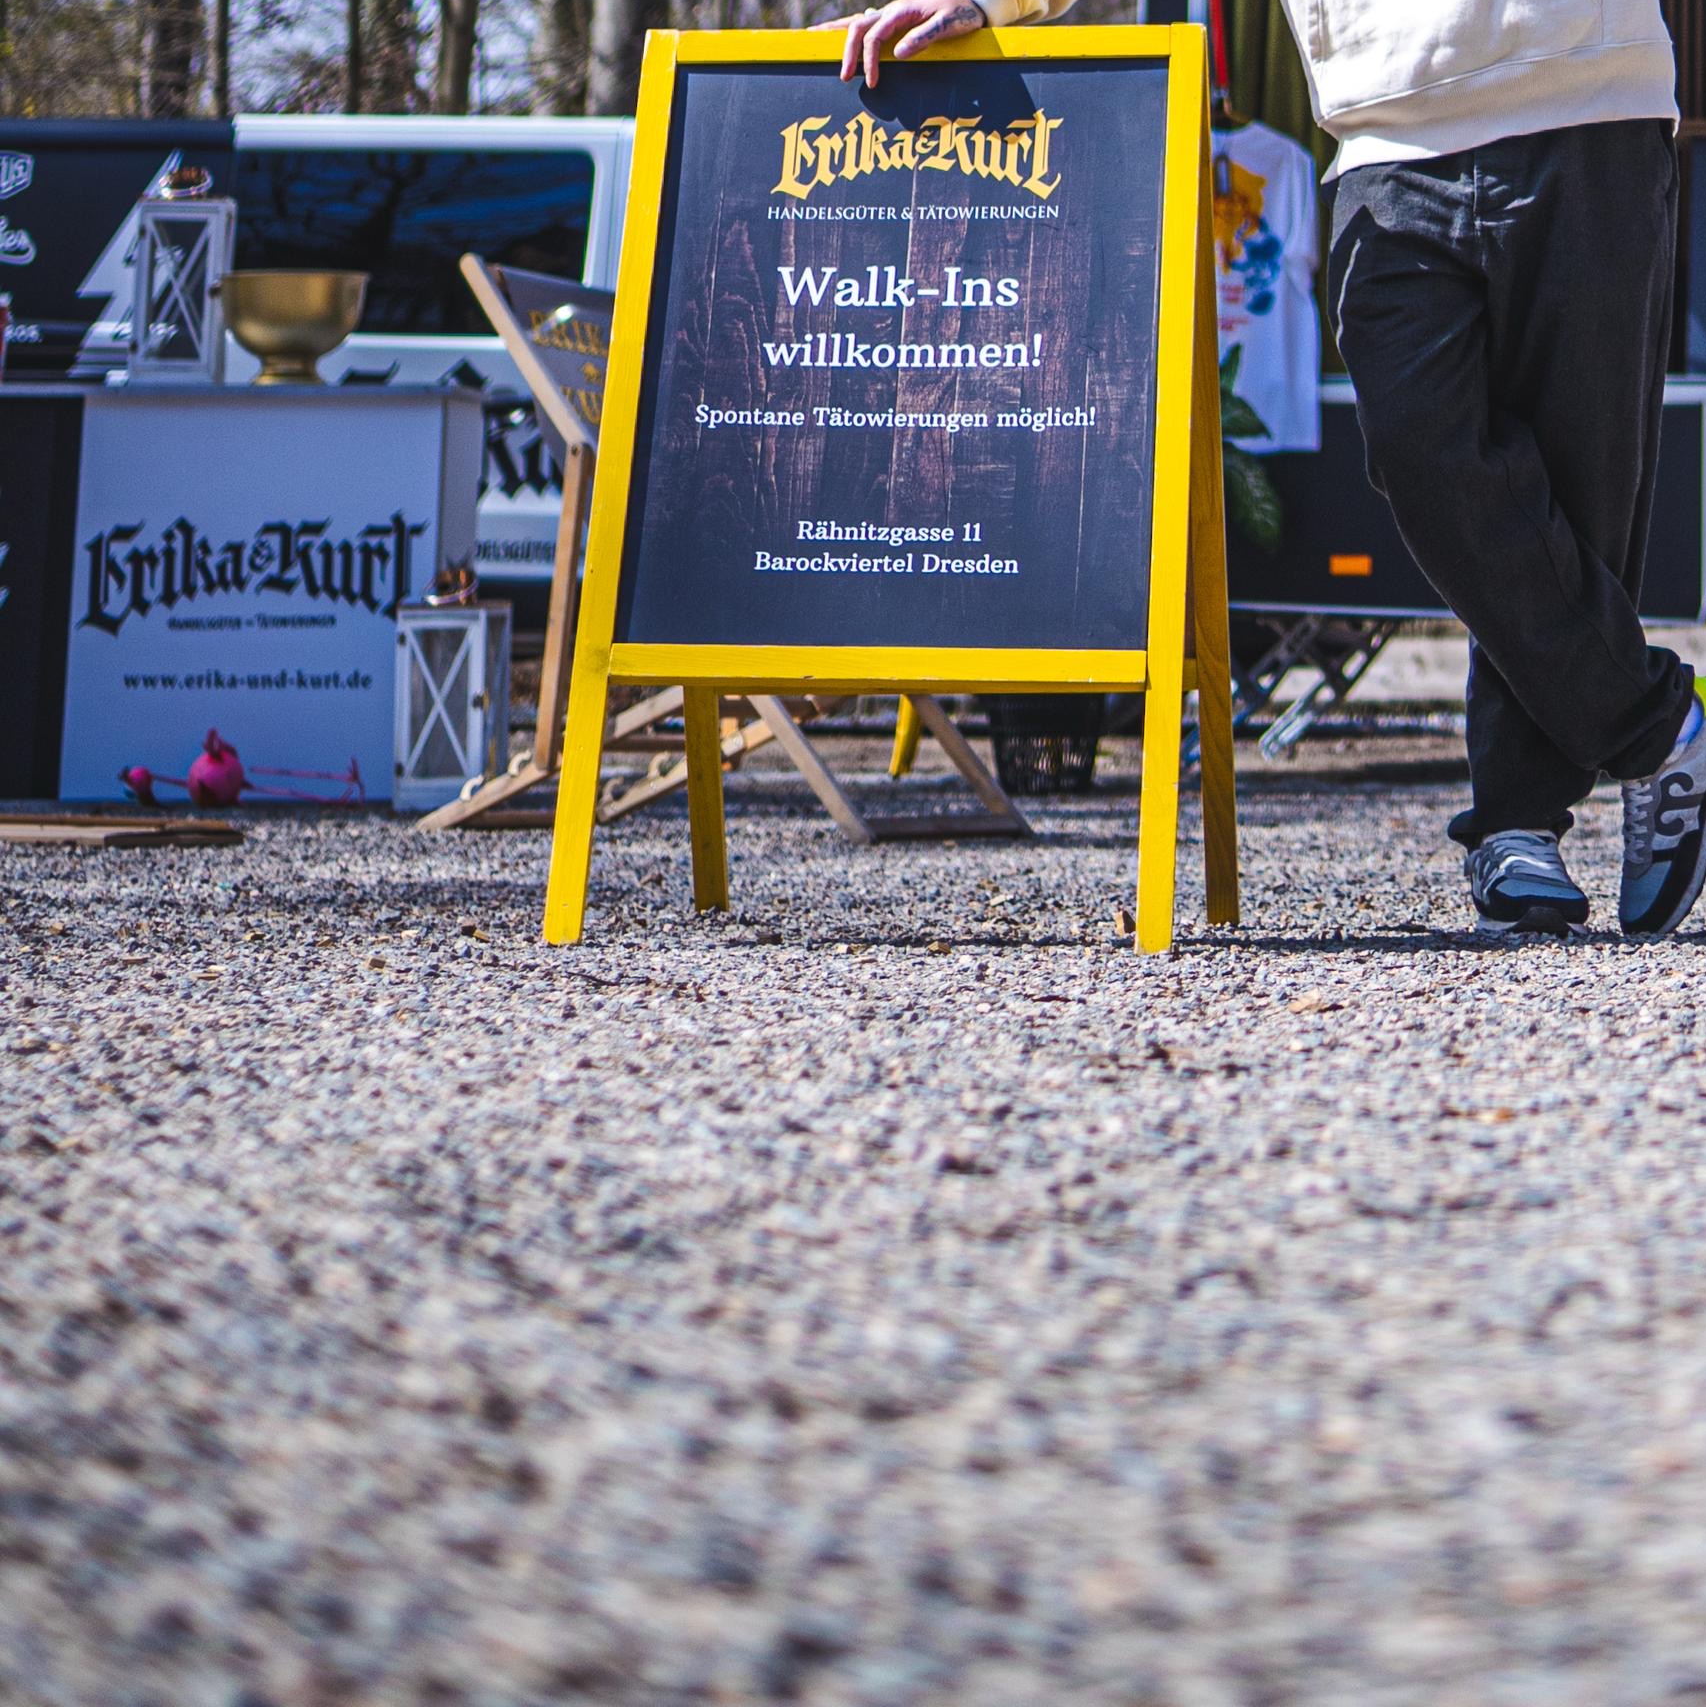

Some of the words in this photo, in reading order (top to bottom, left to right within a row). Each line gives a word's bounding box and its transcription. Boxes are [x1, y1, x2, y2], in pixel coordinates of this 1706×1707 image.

[767, 204, 897, 221] HANDELSGÜTER
[900, 206, 914, 221] &
[917, 204, 1060, 221] TÄTOWIERUNGEN
[777, 266, 1020, 307] Walk-Ins
[763, 332, 1043, 368] willkommen!
[695, 403, 805, 430] Spontane
[812, 406, 989, 433] Tätowierungen
[996, 406, 1096, 432] möglich!
[796, 520, 955, 547] Rähnitzgasse
[961, 522, 982, 542] 11
[754, 551, 914, 573] Barockviertel
[921, 553, 1020, 574] Dresden
[123, 668, 373, 690] www.erika-und-kurt.de
